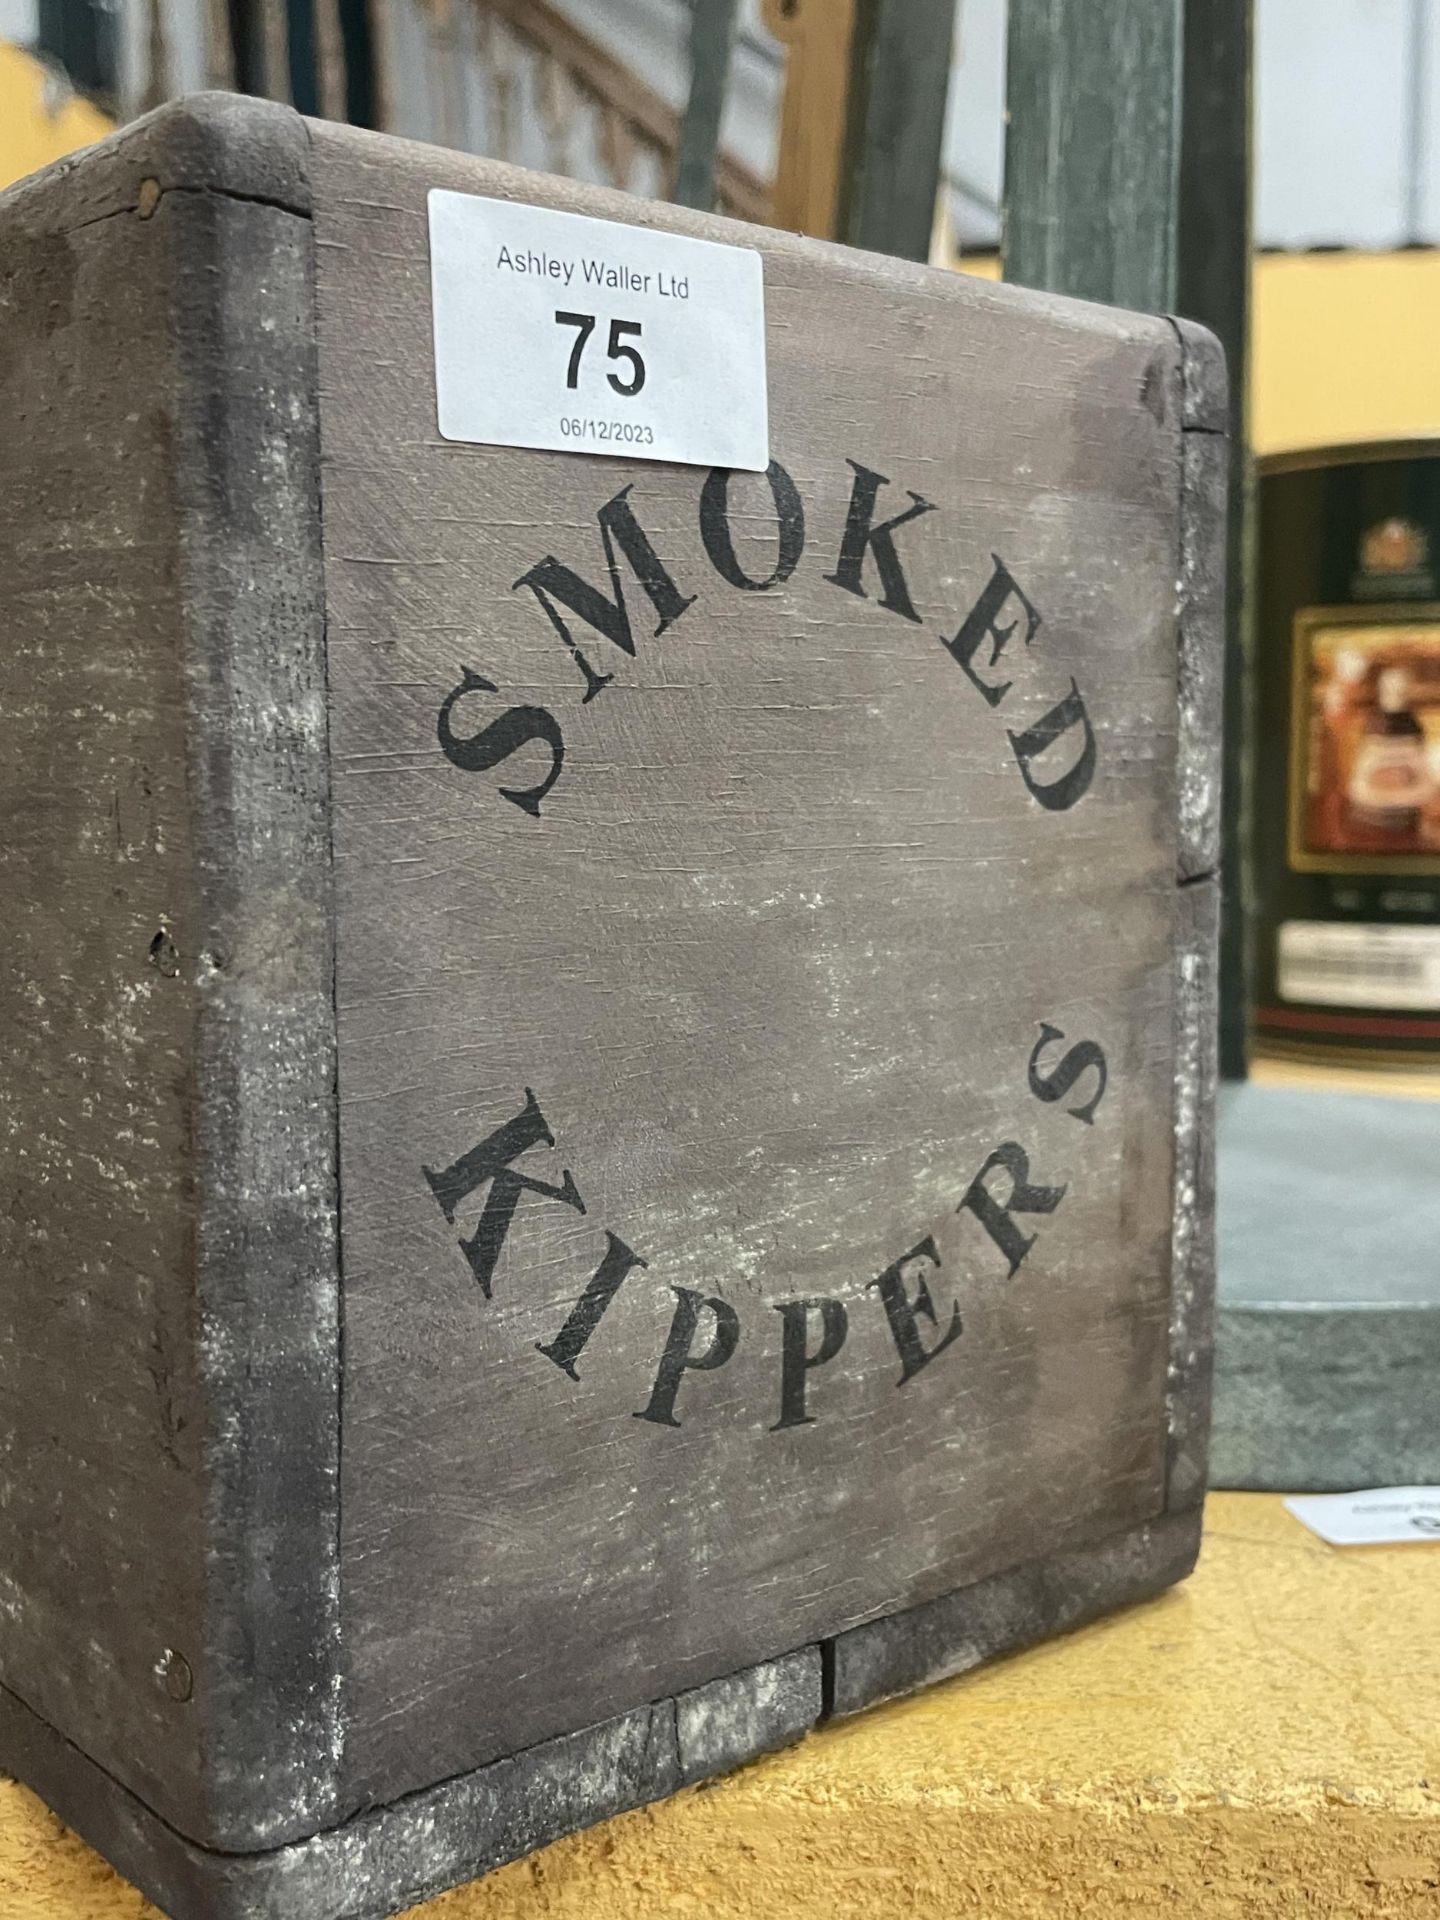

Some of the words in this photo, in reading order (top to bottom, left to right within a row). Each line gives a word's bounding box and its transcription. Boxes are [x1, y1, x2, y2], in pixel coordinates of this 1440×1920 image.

[497, 246, 574, 286] Ashley
[582, 258, 651, 293] Waller
[658, 273, 689, 299] Ltd
[555, 311, 646, 396] 75
[560, 417, 654, 445] 06/12/2023
[437, 458, 1097, 817] SMOKED
[421, 1022, 1107, 1431] KIPPERS
